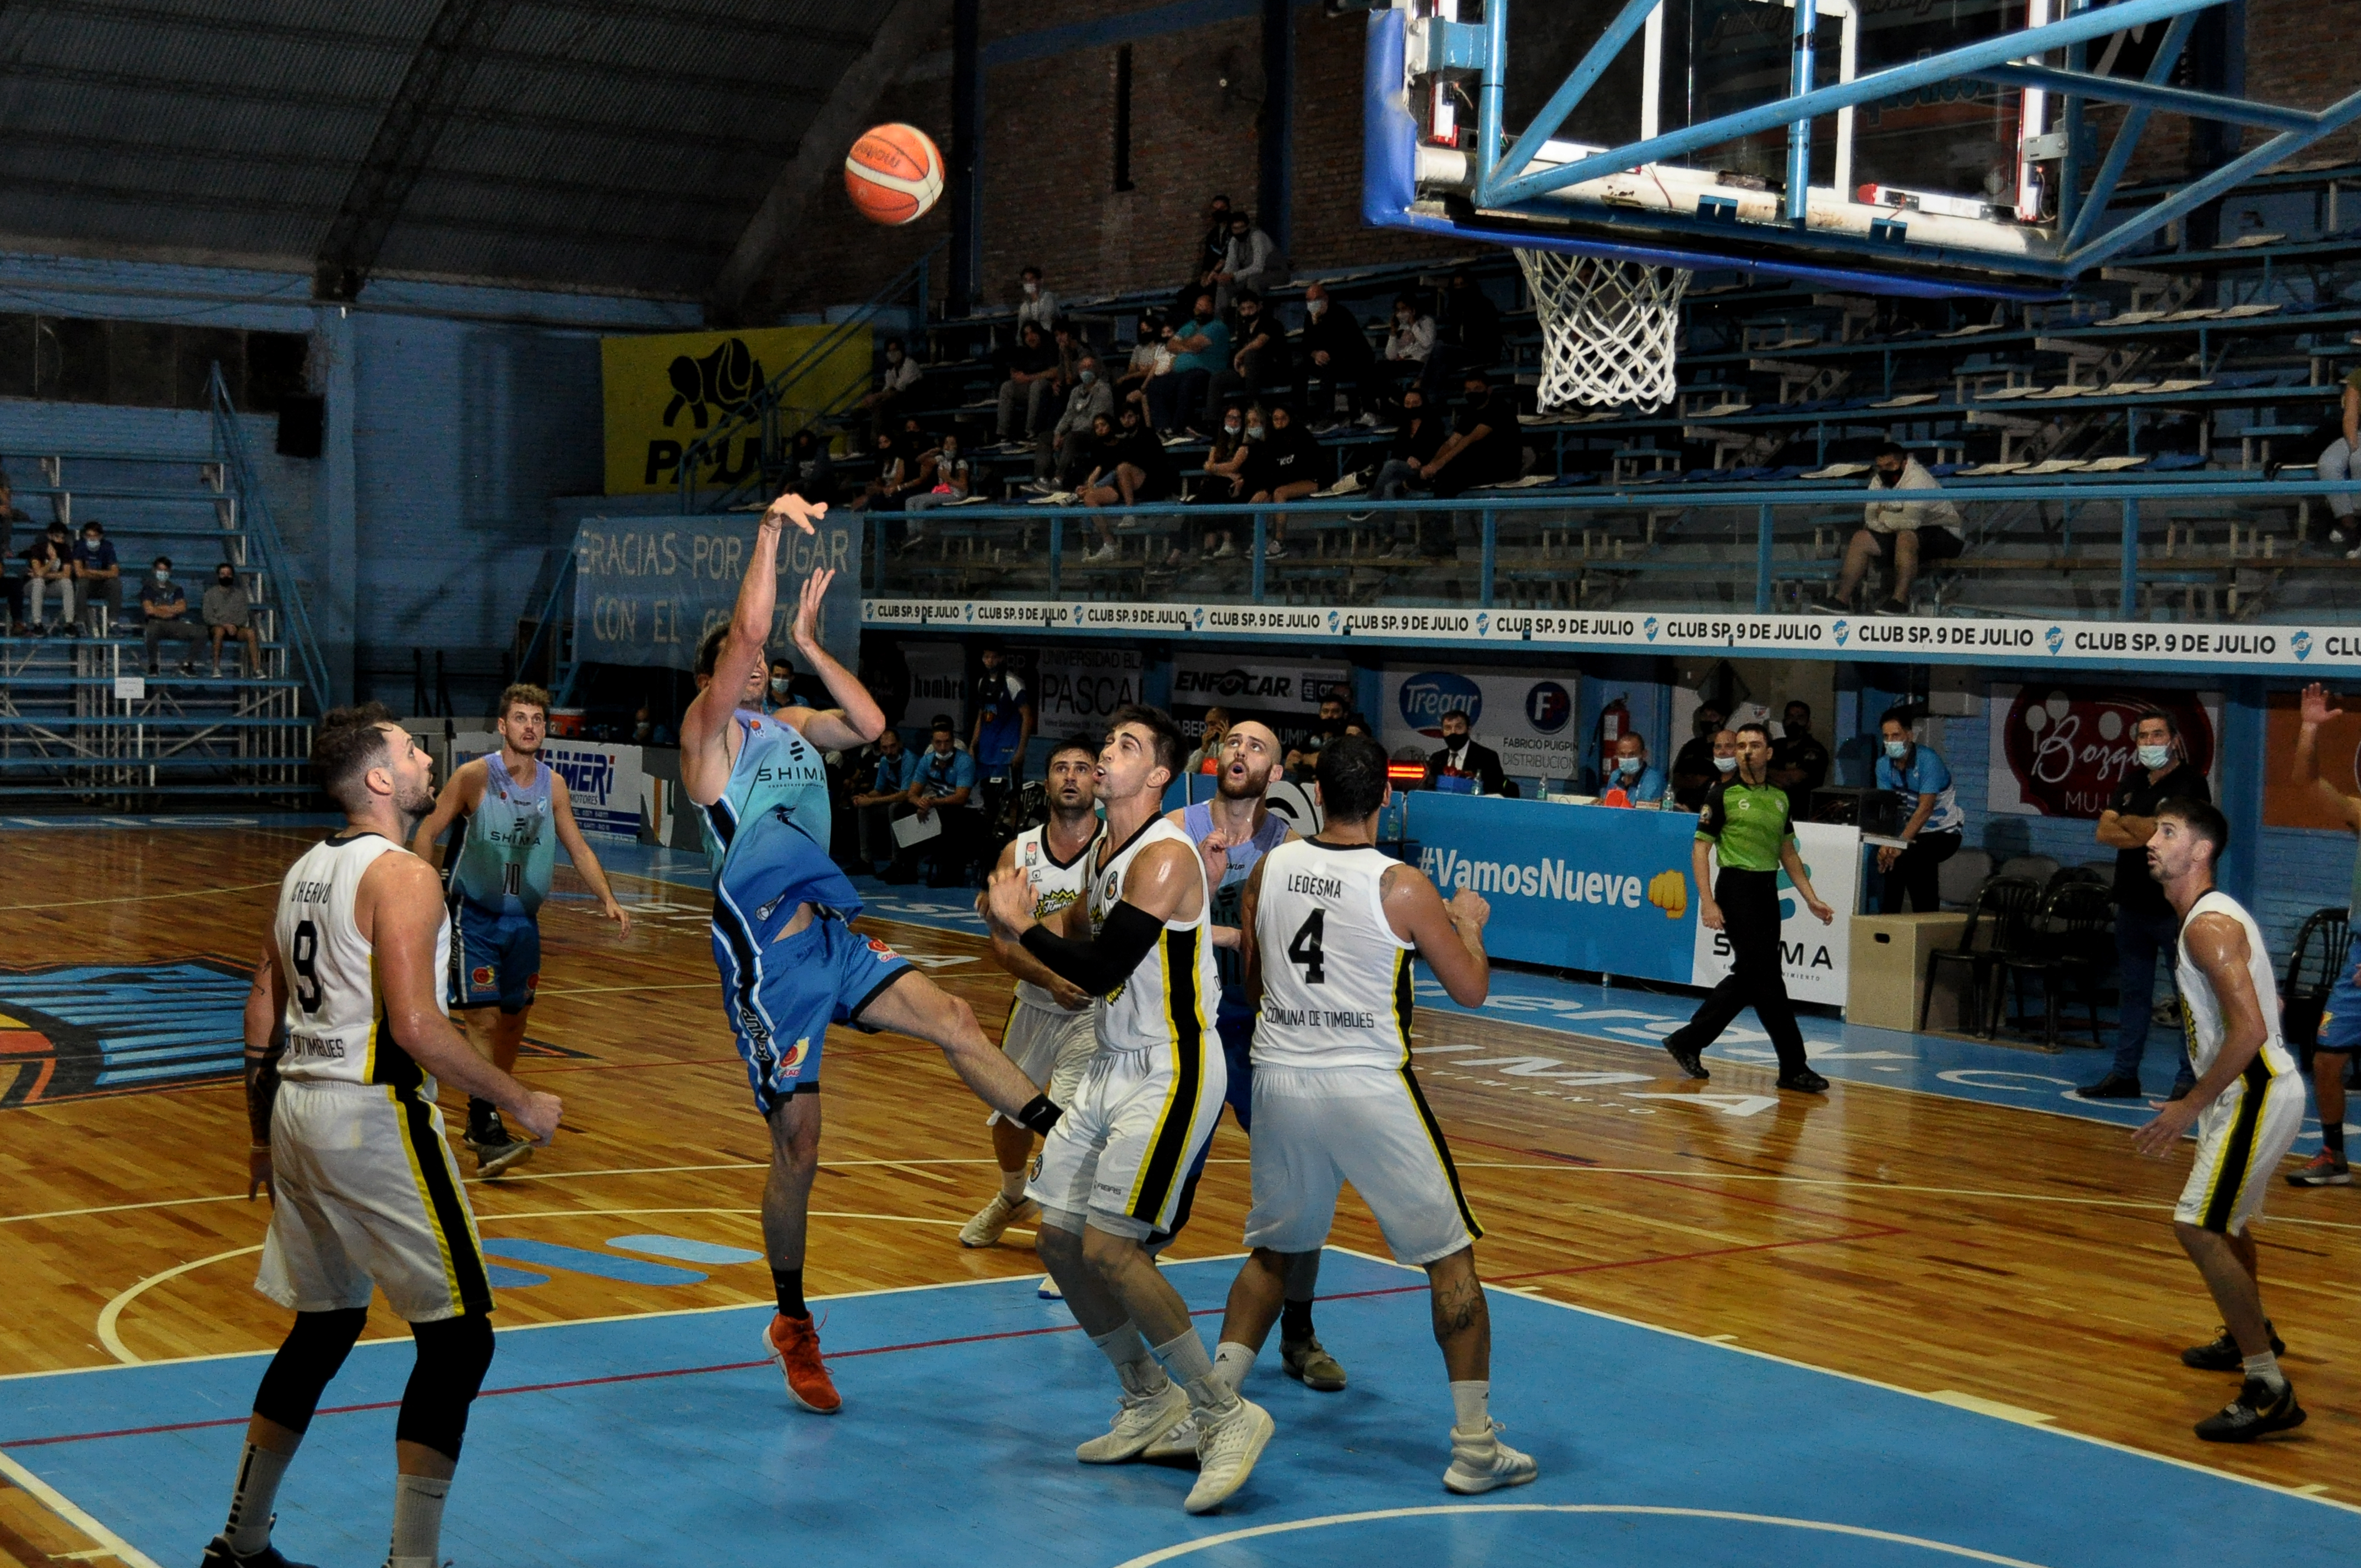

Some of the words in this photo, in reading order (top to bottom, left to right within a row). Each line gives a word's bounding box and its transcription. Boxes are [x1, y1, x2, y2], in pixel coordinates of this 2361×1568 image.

[693, 533, 742, 580] POR
[592, 597, 636, 642] CON
[654, 599, 681, 644] EL
[878, 605, 900, 618] CLUB
[901, 606, 913, 618] SP.
[915, 606, 921, 618] 9
[934, 606, 959, 619] JULIO
[978, 607, 1002, 619] CLUB
[1004, 608, 1017, 620] SP.
[1018, 608, 1024, 620] 9
[1026, 608, 1038, 620] DE
[1040, 608, 1067, 621] JULIO
[1088, 609, 1114, 622] CLUB
[1116, 609, 1130, 622] SP.
[1132, 610, 1138, 622] 9
[1141, 610, 1154, 623] DE
[1156, 611, 1187, 624] JULIO
[1210, 612, 1239, 626] CLUB
[1242, 613, 1257, 627] SP.
[1259, 614, 1266, 627] 9
[1269, 614, 1284, 627] DE
[1286, 615, 1320, 628] JULIO
[1346, 615, 1378, 629] CLUB
[1381, 616, 1399, 630] SP.
[1402, 616, 1408, 630] 9
[1412, 617, 1428, 630] DE
[1431, 617, 1468, 631] JULIO
[1497, 617, 1532, 633] CLUB
[1536, 618, 1555, 633] SP.
[1558, 619, 1566, 634] 9
[1570, 619, 1588, 634] DE
[1591, 620, 1634, 635] JULIO
[1667, 622, 1707, 638] CLUB
[1737, 623, 1746, 639] 9
[1750, 624, 1771, 639] DE
[1774, 624, 1821, 640] JULIO
[1859, 625, 1904, 643] CLUB
[1908, 627, 1933, 644] SP.
[1937, 628, 1947, 644] 9
[1952, 628, 1976, 645] DE
[1979, 629, 2033, 646] JULIO
[2075, 633, 2127, 650] CLUB
[2132, 634, 2160, 651] SP.
[2165, 634, 2177, 652] 9
[2182, 635, 2209, 652] DE
[2213, 635, 2276, 654] JULIO
[1042, 650, 1119, 668] UNIVERSIDAD
[1503, 737, 1543, 749] FABRICIO
[758, 767, 825, 782] SHIMA
[2065, 790, 2110, 813] MUJ
[490, 830, 541, 846] SHIMA
[503, 862, 520, 896] 10
[1287, 873, 1341, 899] LEDESMA
[1287, 907, 1326, 984] 4
[1712, 933, 1834, 971] SMA
[292, 920, 322, 1014] 9
[1266, 1006, 1305, 1026] COMUNA
[1309, 1010, 1321, 1027] DE
[1323, 1011, 1375, 1029] TIMBUES
[301, 1036, 345, 1058] TIMBUES
